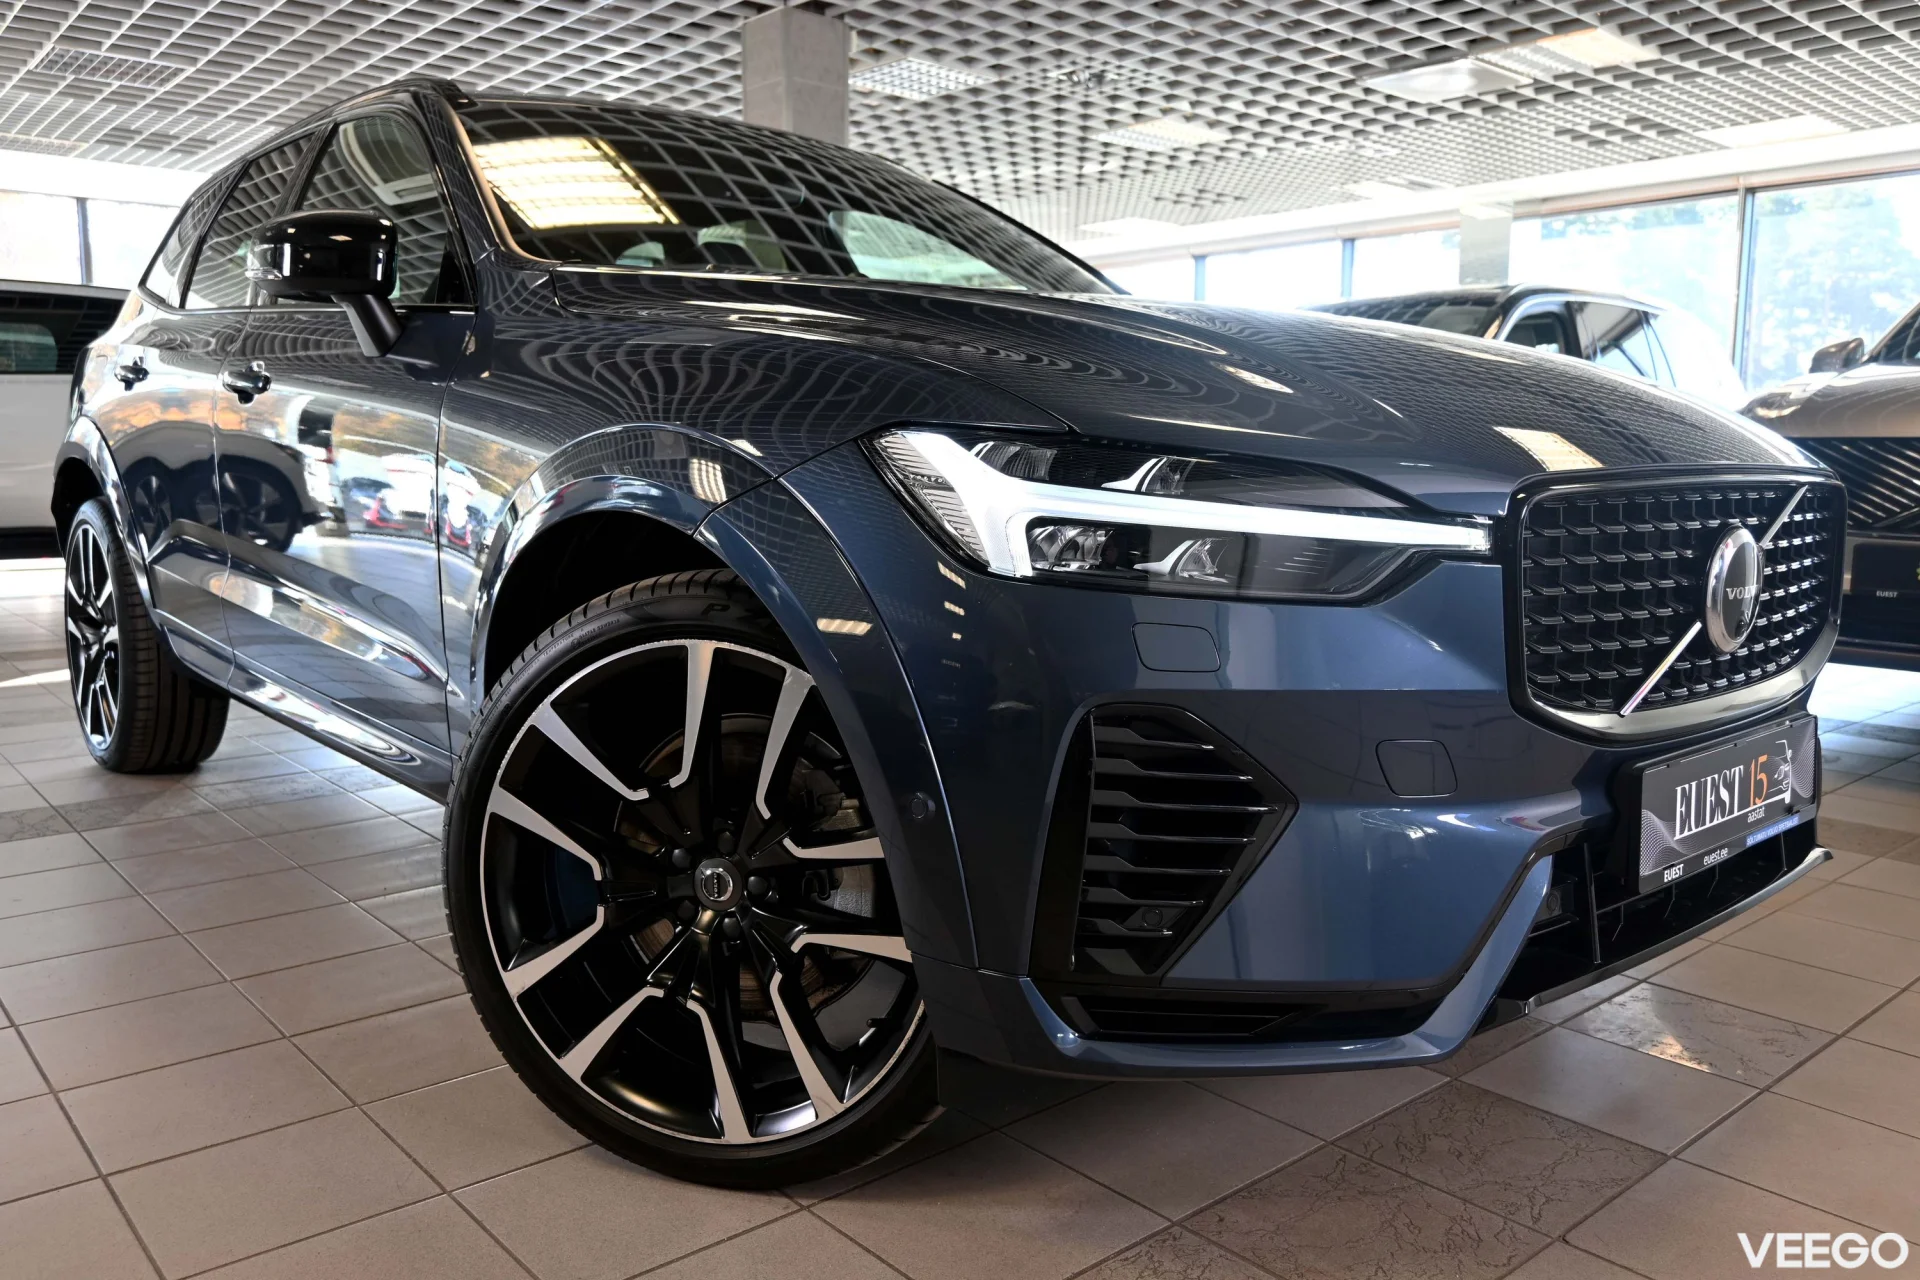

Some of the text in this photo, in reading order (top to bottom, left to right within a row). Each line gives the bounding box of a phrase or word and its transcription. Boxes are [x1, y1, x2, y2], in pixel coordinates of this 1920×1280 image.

[1726, 585, 1758, 600] VOLV
[1876, 590, 1898, 598] EUEST
[1674, 754, 1768, 840] EUEST 15
[1747, 806, 1765, 823] aastat
[1663, 848, 1728, 882] EUEST euest.ee
